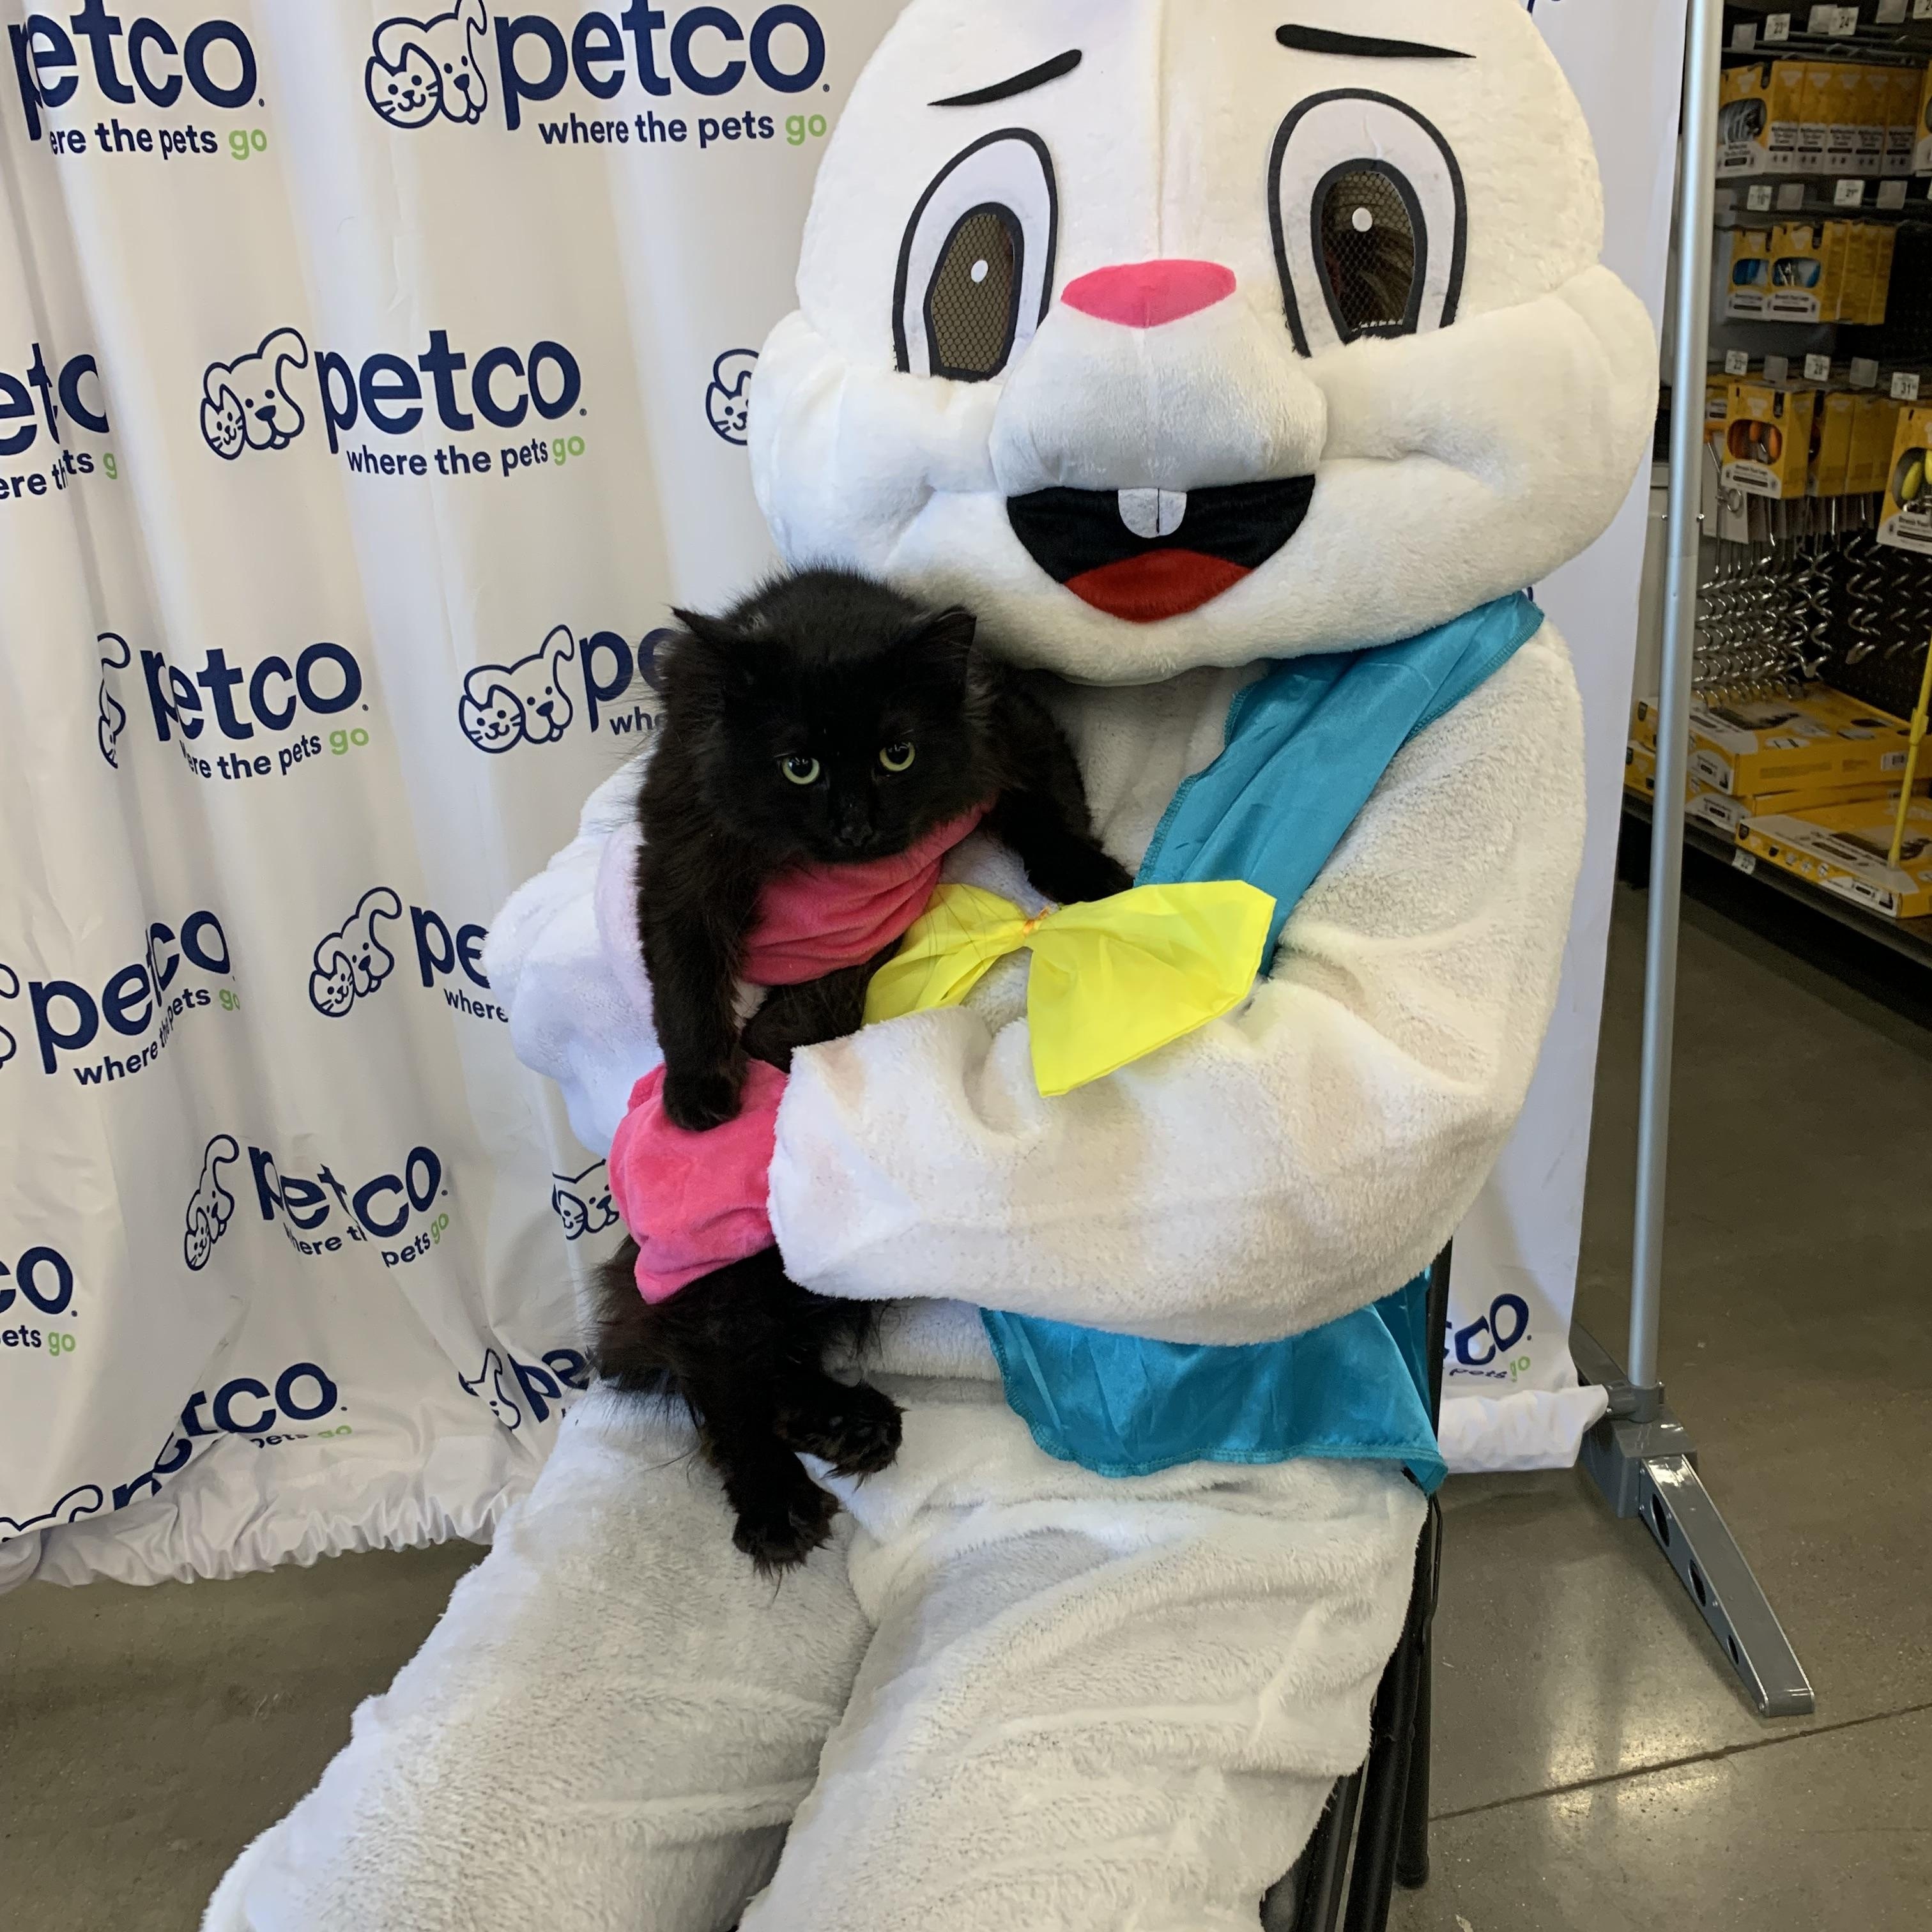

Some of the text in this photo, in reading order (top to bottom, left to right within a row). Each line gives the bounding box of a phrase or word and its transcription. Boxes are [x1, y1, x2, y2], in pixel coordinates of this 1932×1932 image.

[494, 0, 825, 131] petco
[50, 119, 267, 160] ere the pets go
[539, 111, 827, 148] where the pets go
[314, 330, 581, 454] petco
[347, 436, 585, 477] where the pets go
[217, 753, 271, 779] the
[279, 735, 321, 776] pets
[330, 728, 369, 755] go
[73, 1041, 158, 1085] where
[167, 988, 211, 1031] pets
[218, 989, 240, 1011] go
[381, 1232, 424, 1268] pets
[431, 1213, 449, 1245] go
[0, 1325, 76, 1356] ets go
